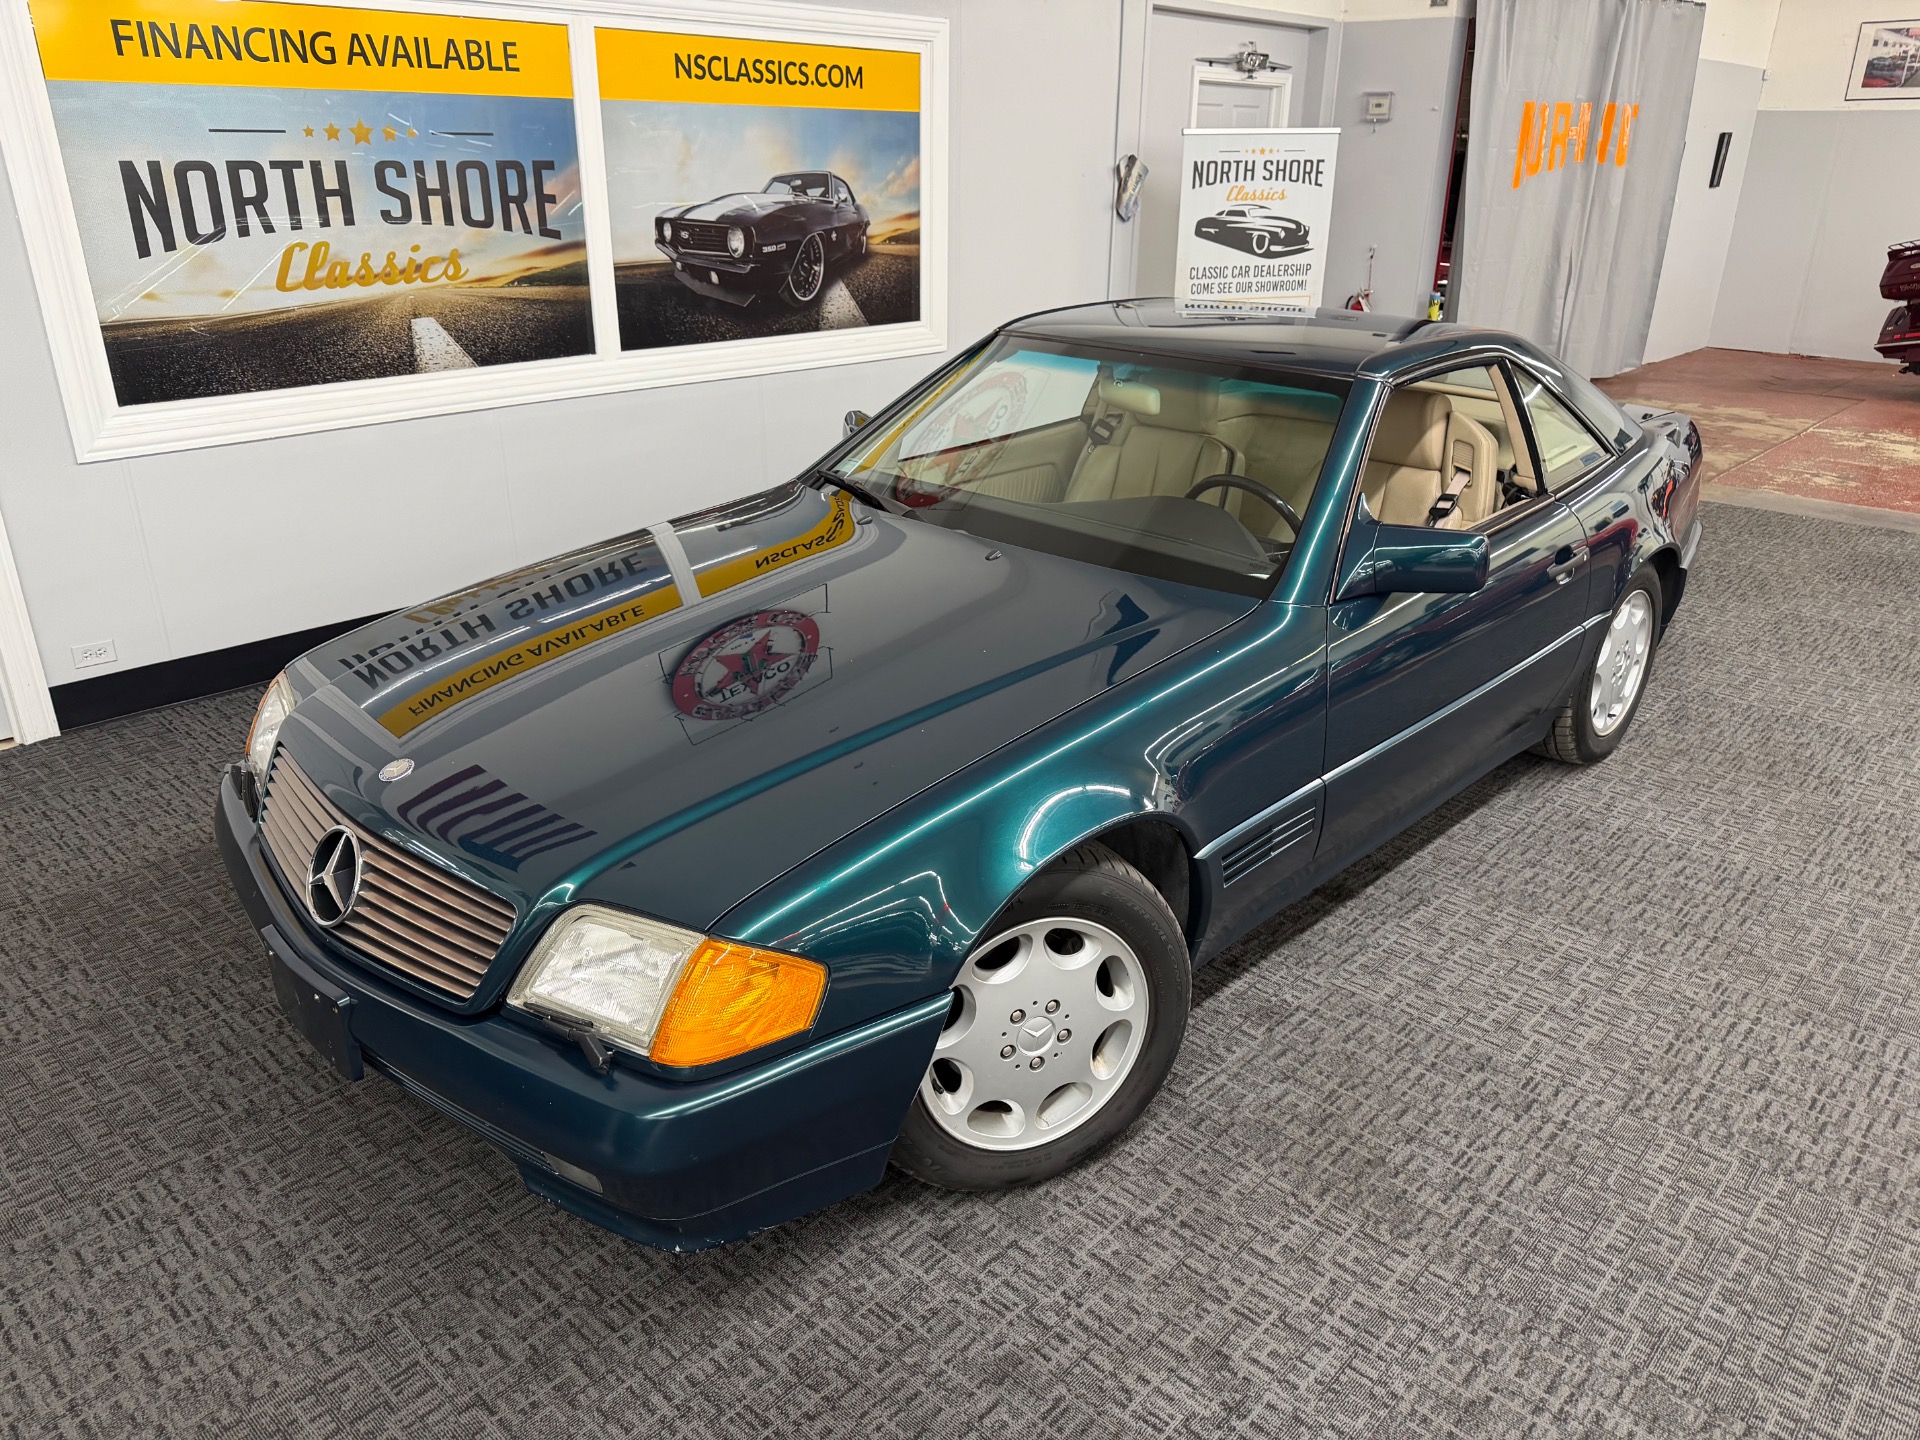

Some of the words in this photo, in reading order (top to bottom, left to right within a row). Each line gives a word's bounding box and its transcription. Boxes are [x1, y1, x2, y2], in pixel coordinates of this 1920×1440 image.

[110, 19, 336, 65] FINANCING
[347, 33, 521, 73] AVAILABLE
[674, 53, 864, 90] NSCLASSICS.COM
[1192, 160, 1256, 190] NORTH
[1262, 158, 1326, 188] SHORE
[118, 159, 357, 260] NORTH
[373, 159, 563, 241] SHORE
[1226, 185, 1288, 202] Classics
[274, 240, 469, 293] Classics
[1189, 265, 1229, 280] CLASSIC
[1231, 264, 1250, 279] CAR
[1253, 263, 1312, 279] DEALERSHIP
[1190, 282, 1215, 295] COME
[1217, 282, 1233, 294] SEE
[1235, 281, 1253, 293] OUR
[1254, 279, 1308, 293] SHOWROOM!
